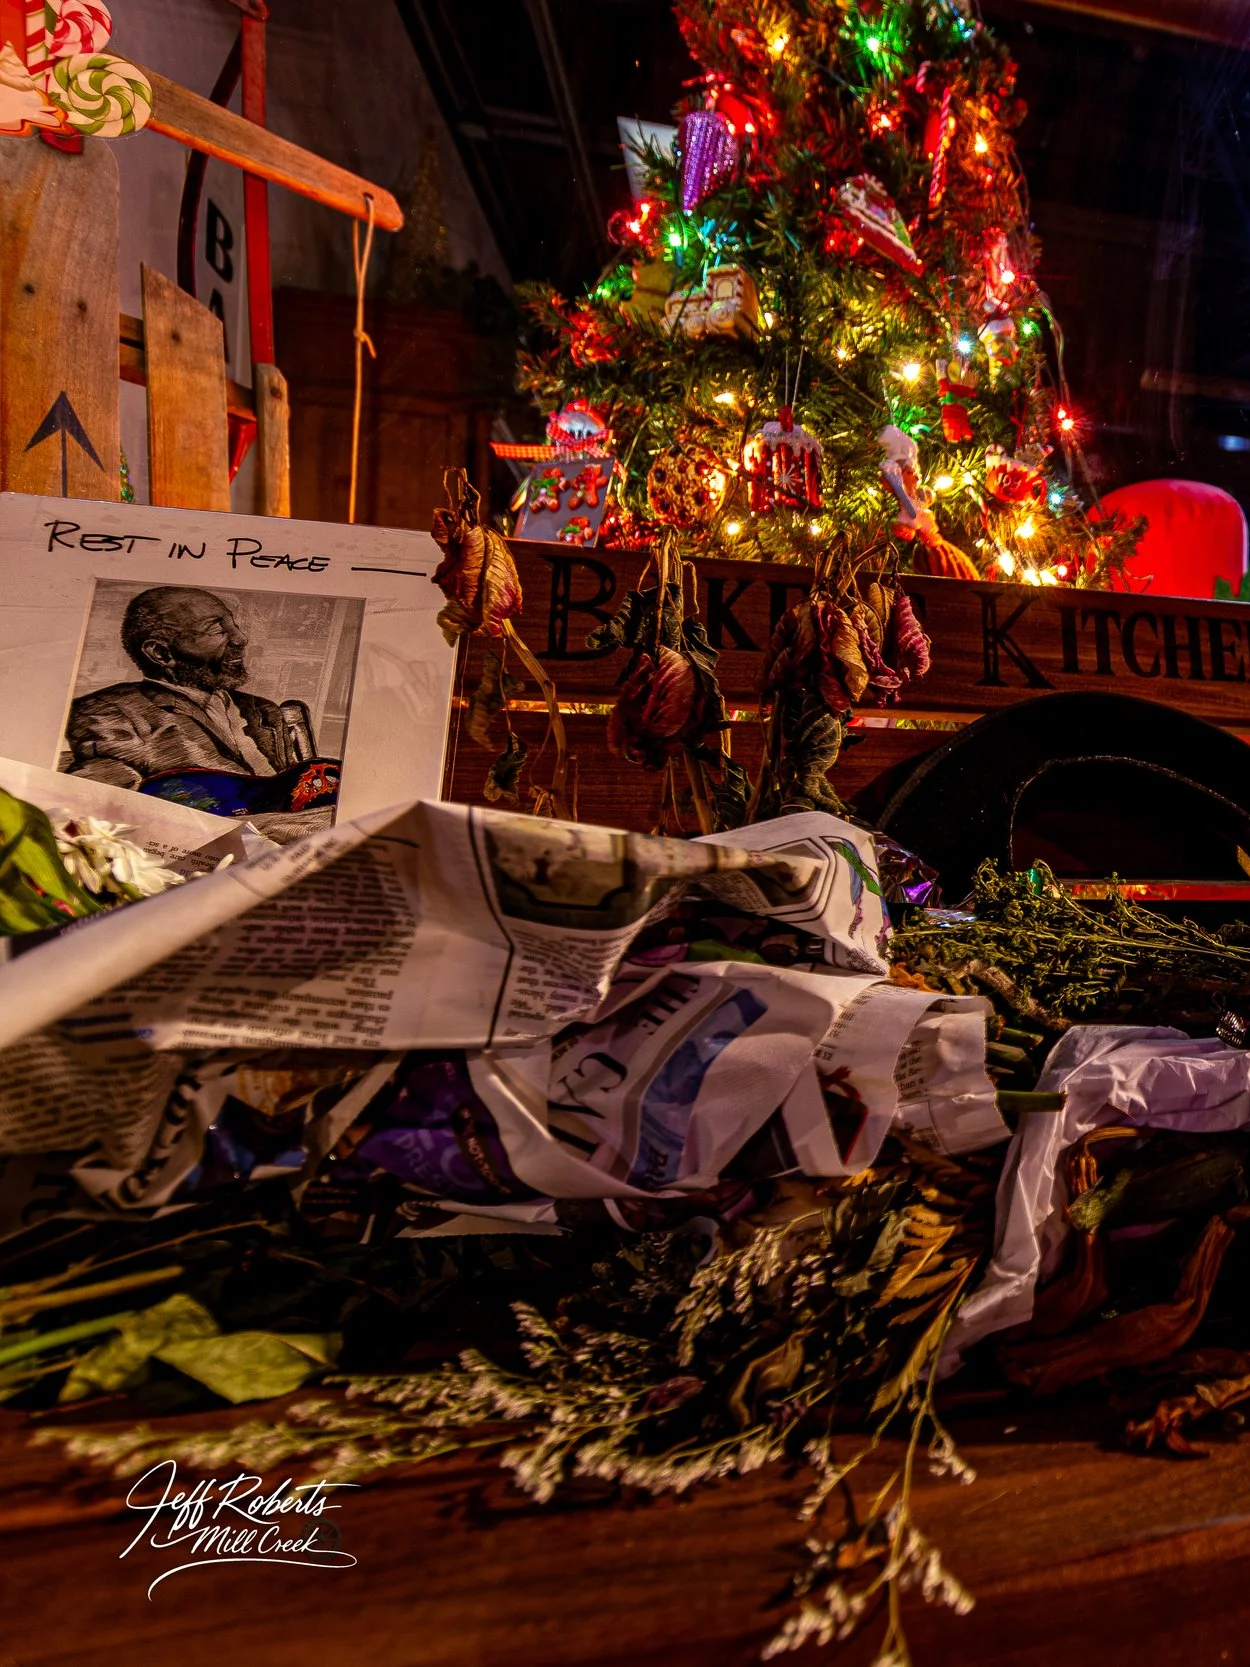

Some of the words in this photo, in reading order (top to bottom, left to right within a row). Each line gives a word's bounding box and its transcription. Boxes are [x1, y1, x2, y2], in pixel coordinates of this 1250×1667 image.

[44, 520, 160, 553] REST
[168, 541, 207, 560] IN
[227, 537, 331, 573] PEACE
